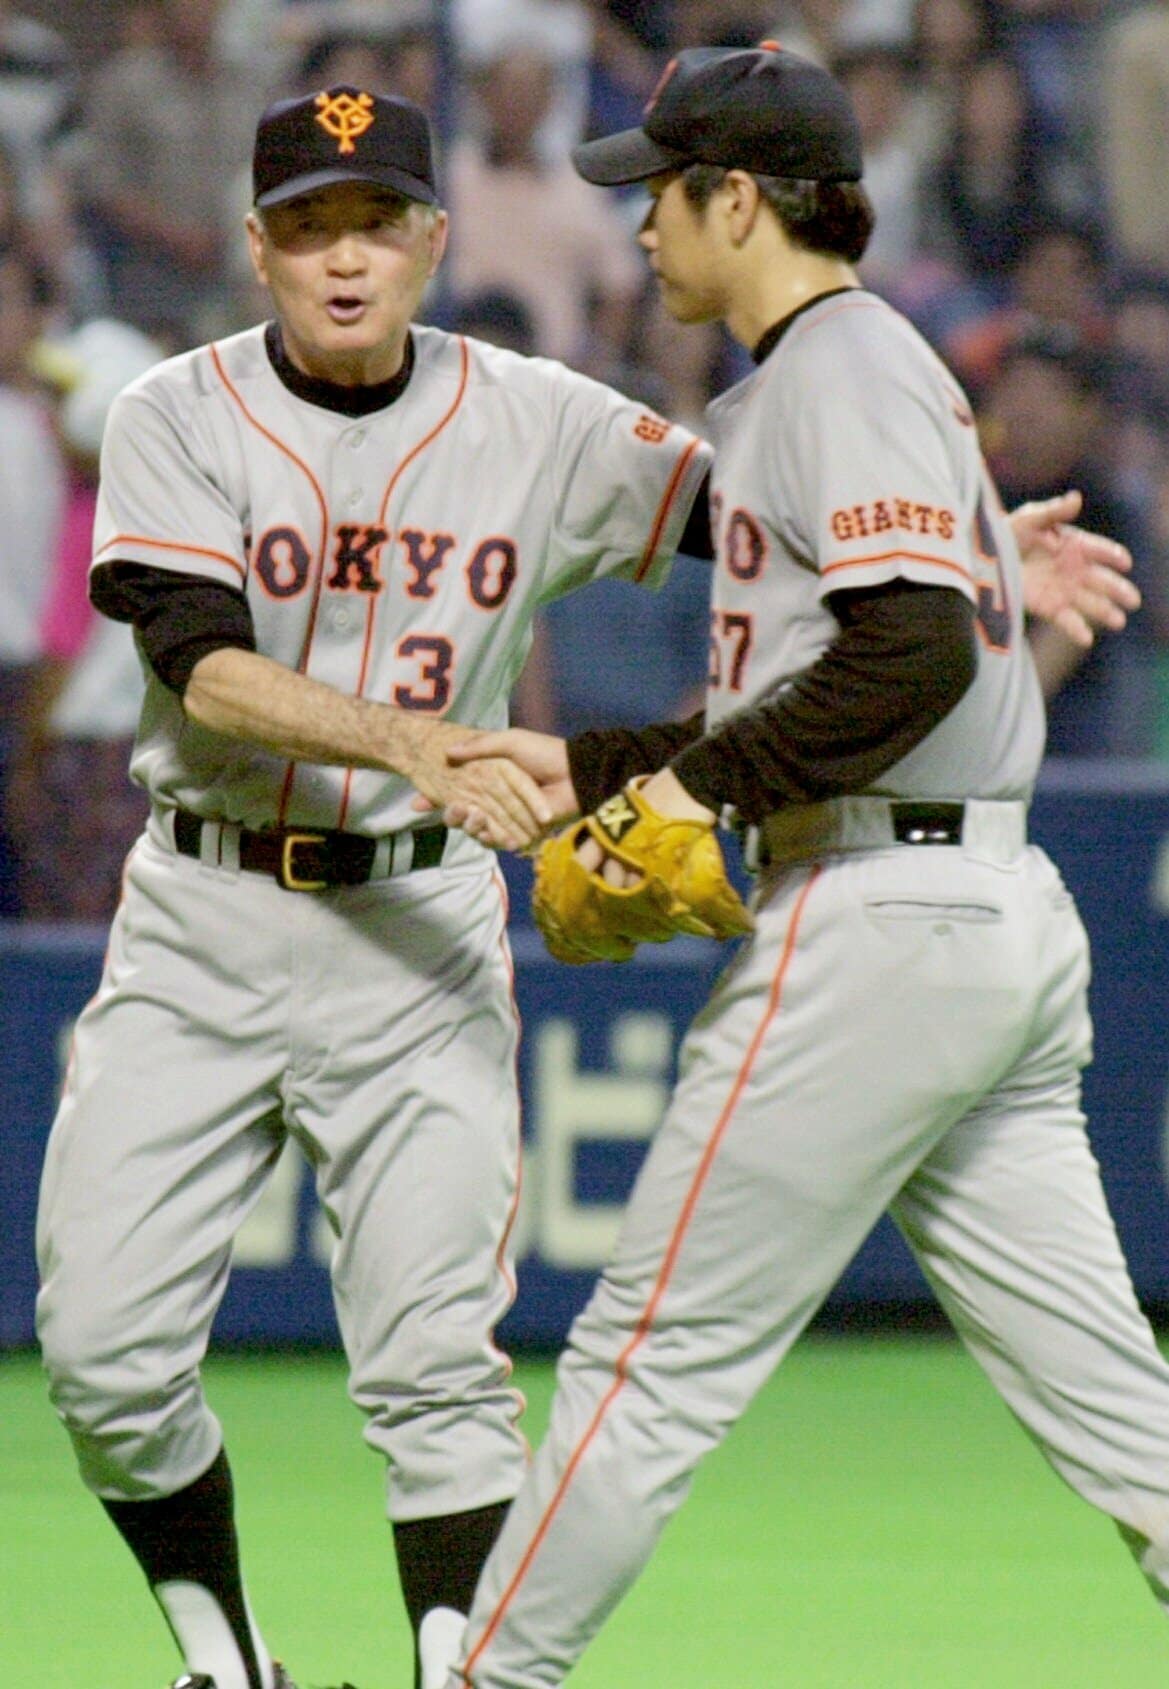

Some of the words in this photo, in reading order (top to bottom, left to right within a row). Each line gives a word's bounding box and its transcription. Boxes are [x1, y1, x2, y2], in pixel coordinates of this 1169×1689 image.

[831, 498, 956, 541] GIANTS
[243, 524, 518, 611] OKYO
[392, 634, 455, 716] 3
